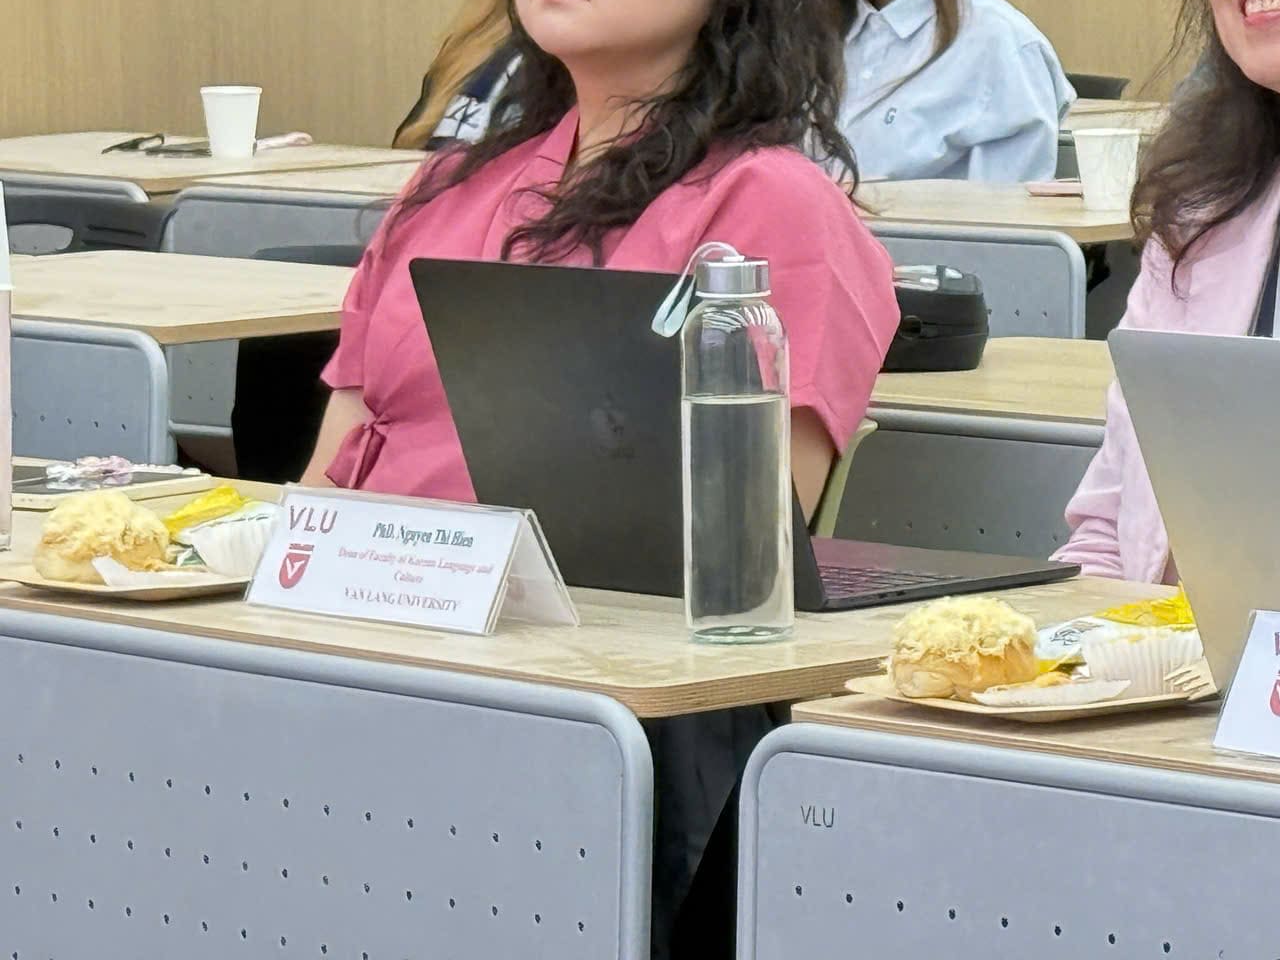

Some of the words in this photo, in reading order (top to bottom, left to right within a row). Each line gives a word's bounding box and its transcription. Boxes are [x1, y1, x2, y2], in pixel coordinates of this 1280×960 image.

[290, 505, 338, 534] VLU
[397, 593, 459, 611] UNIVERSITY
[800, 805, 835, 828] VLU
